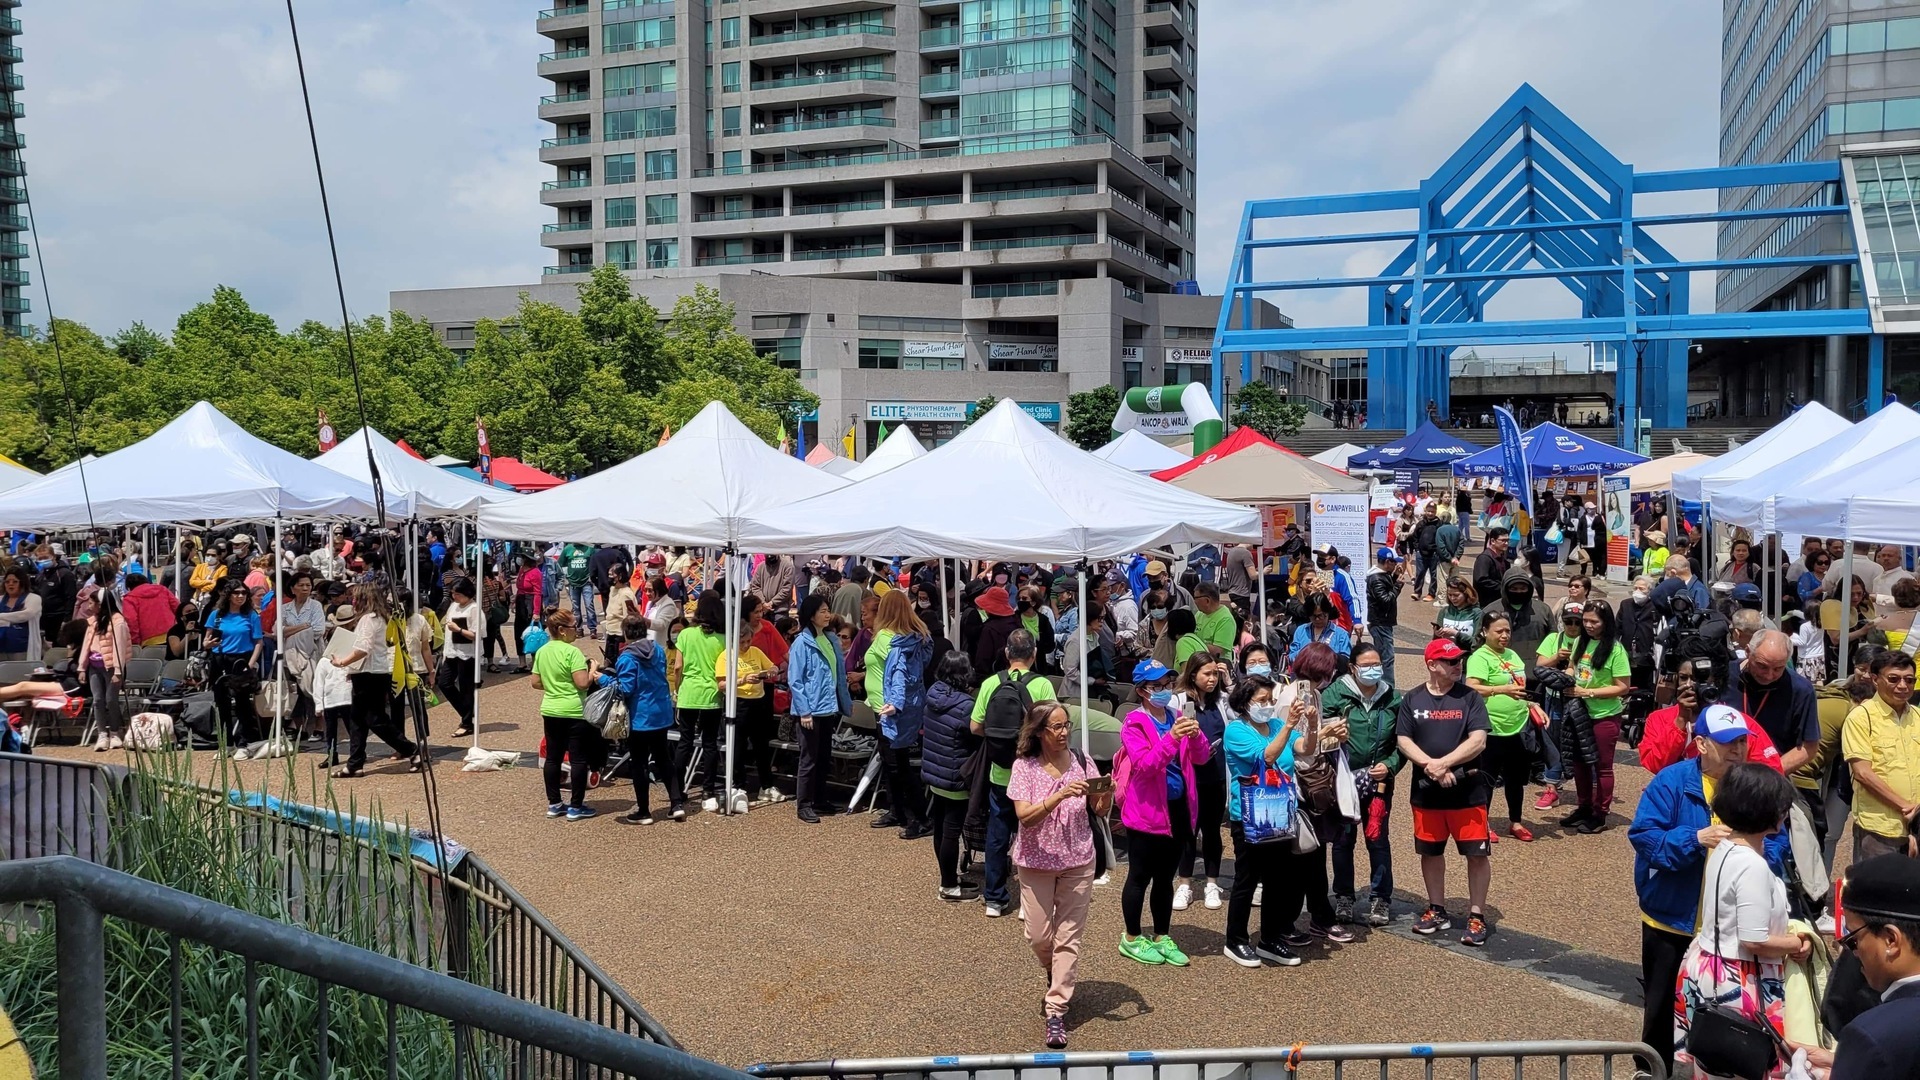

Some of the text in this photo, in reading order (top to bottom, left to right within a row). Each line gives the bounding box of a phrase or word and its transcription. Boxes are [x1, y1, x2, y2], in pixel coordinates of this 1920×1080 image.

[905, 346, 925, 355] Shear
[926, 342, 945, 353] Hand
[946, 341, 963, 350] Hair
[991, 344, 1057, 358] Shear Hand Hair
[871, 405, 905, 417] ELITE
[1141, 416, 1189, 427] ANCOP WALK
[1326, 504, 1364, 512] CANPAYBILLS
